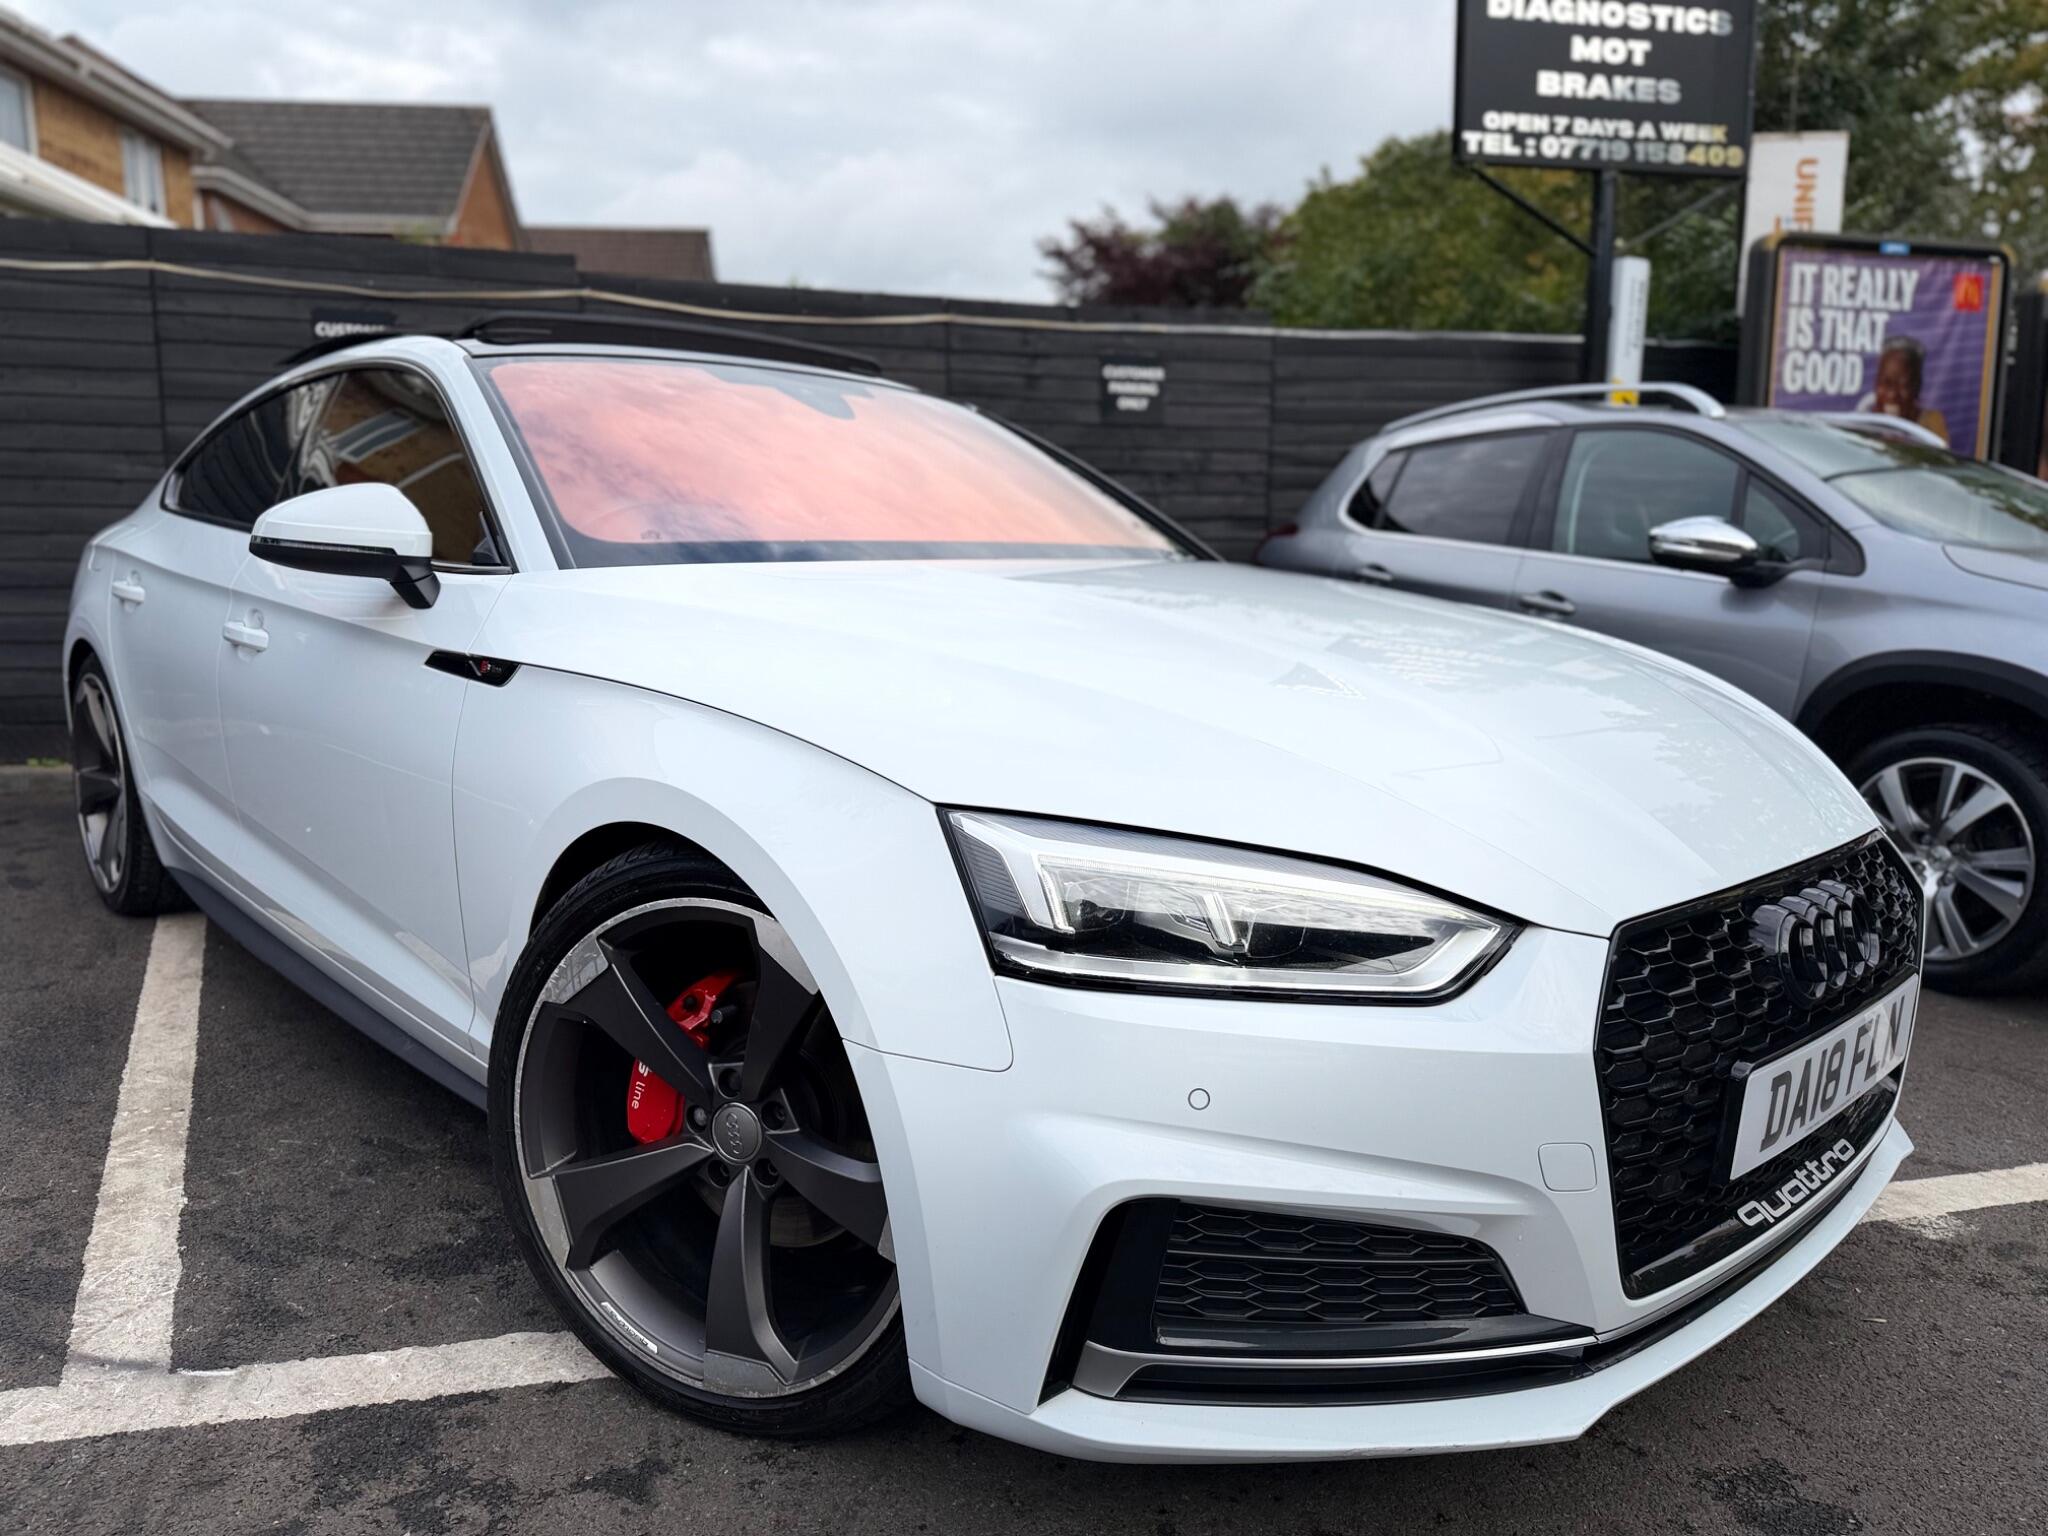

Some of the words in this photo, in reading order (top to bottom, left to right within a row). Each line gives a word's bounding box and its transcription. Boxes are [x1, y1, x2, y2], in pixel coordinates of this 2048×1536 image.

[1487, 0, 1733, 35] DIAGNOSTICS
[1570, 35, 1651, 66] MOT
[1536, 70, 1682, 104] BRAKES
[1483, 110, 1549, 133] OPEN
[1553, 115, 1569, 134] 7
[1572, 116, 1634, 139] DAYS
[1637, 120, 1656, 141] A
[1660, 122, 1727, 143] WEEK
[1789, 262, 1817, 304] IT
[1821, 264, 1919, 311] REALLY
[1786, 307, 1813, 349] IS
[1819, 308, 1890, 352] THAT
[1783, 352, 1863, 395] GOOD
[631, 1081, 646, 1109] line
[1759, 1038, 1847, 1153] DA18
[1737, 1137, 1856, 1227] quattro
